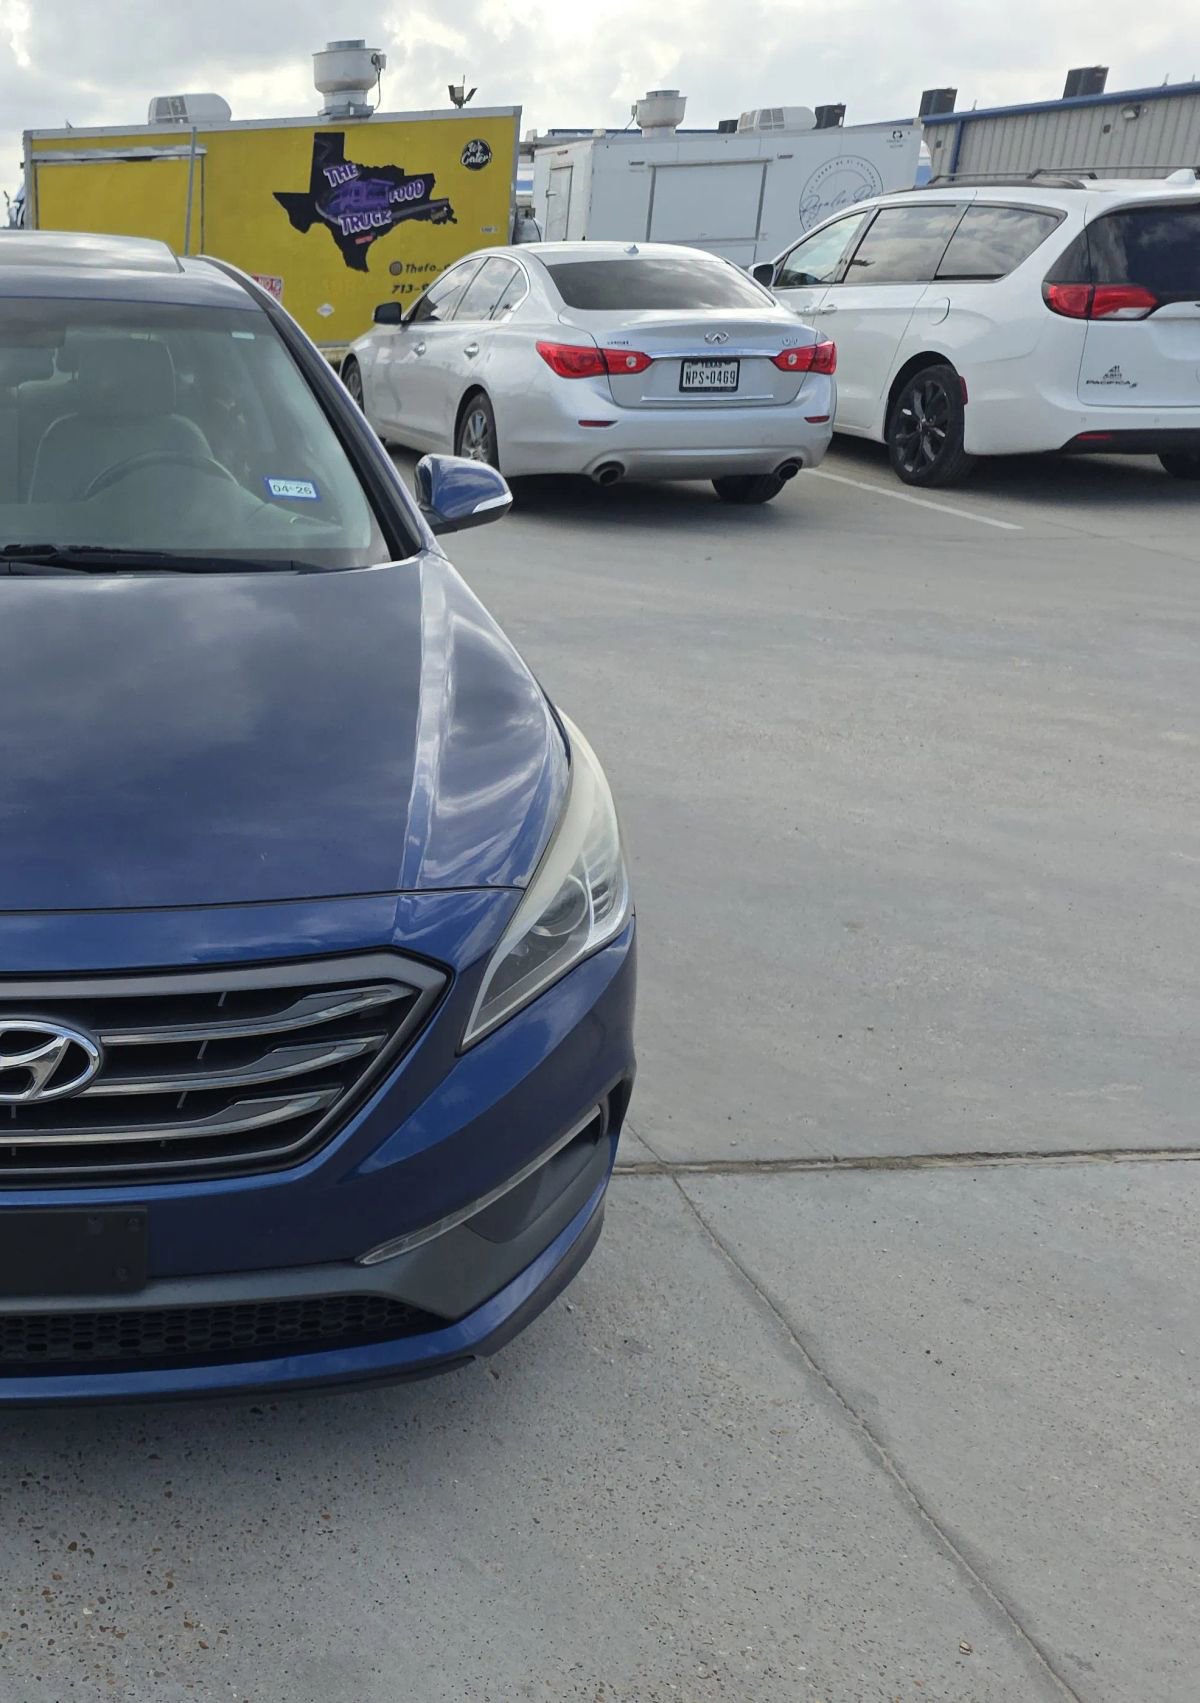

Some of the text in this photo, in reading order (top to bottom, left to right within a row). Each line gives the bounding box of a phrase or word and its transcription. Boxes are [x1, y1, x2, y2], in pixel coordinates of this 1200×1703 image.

[323, 164, 359, 188] THE
[388, 179, 425, 203] FOOD
[337, 210, 392, 236] TRUCK
